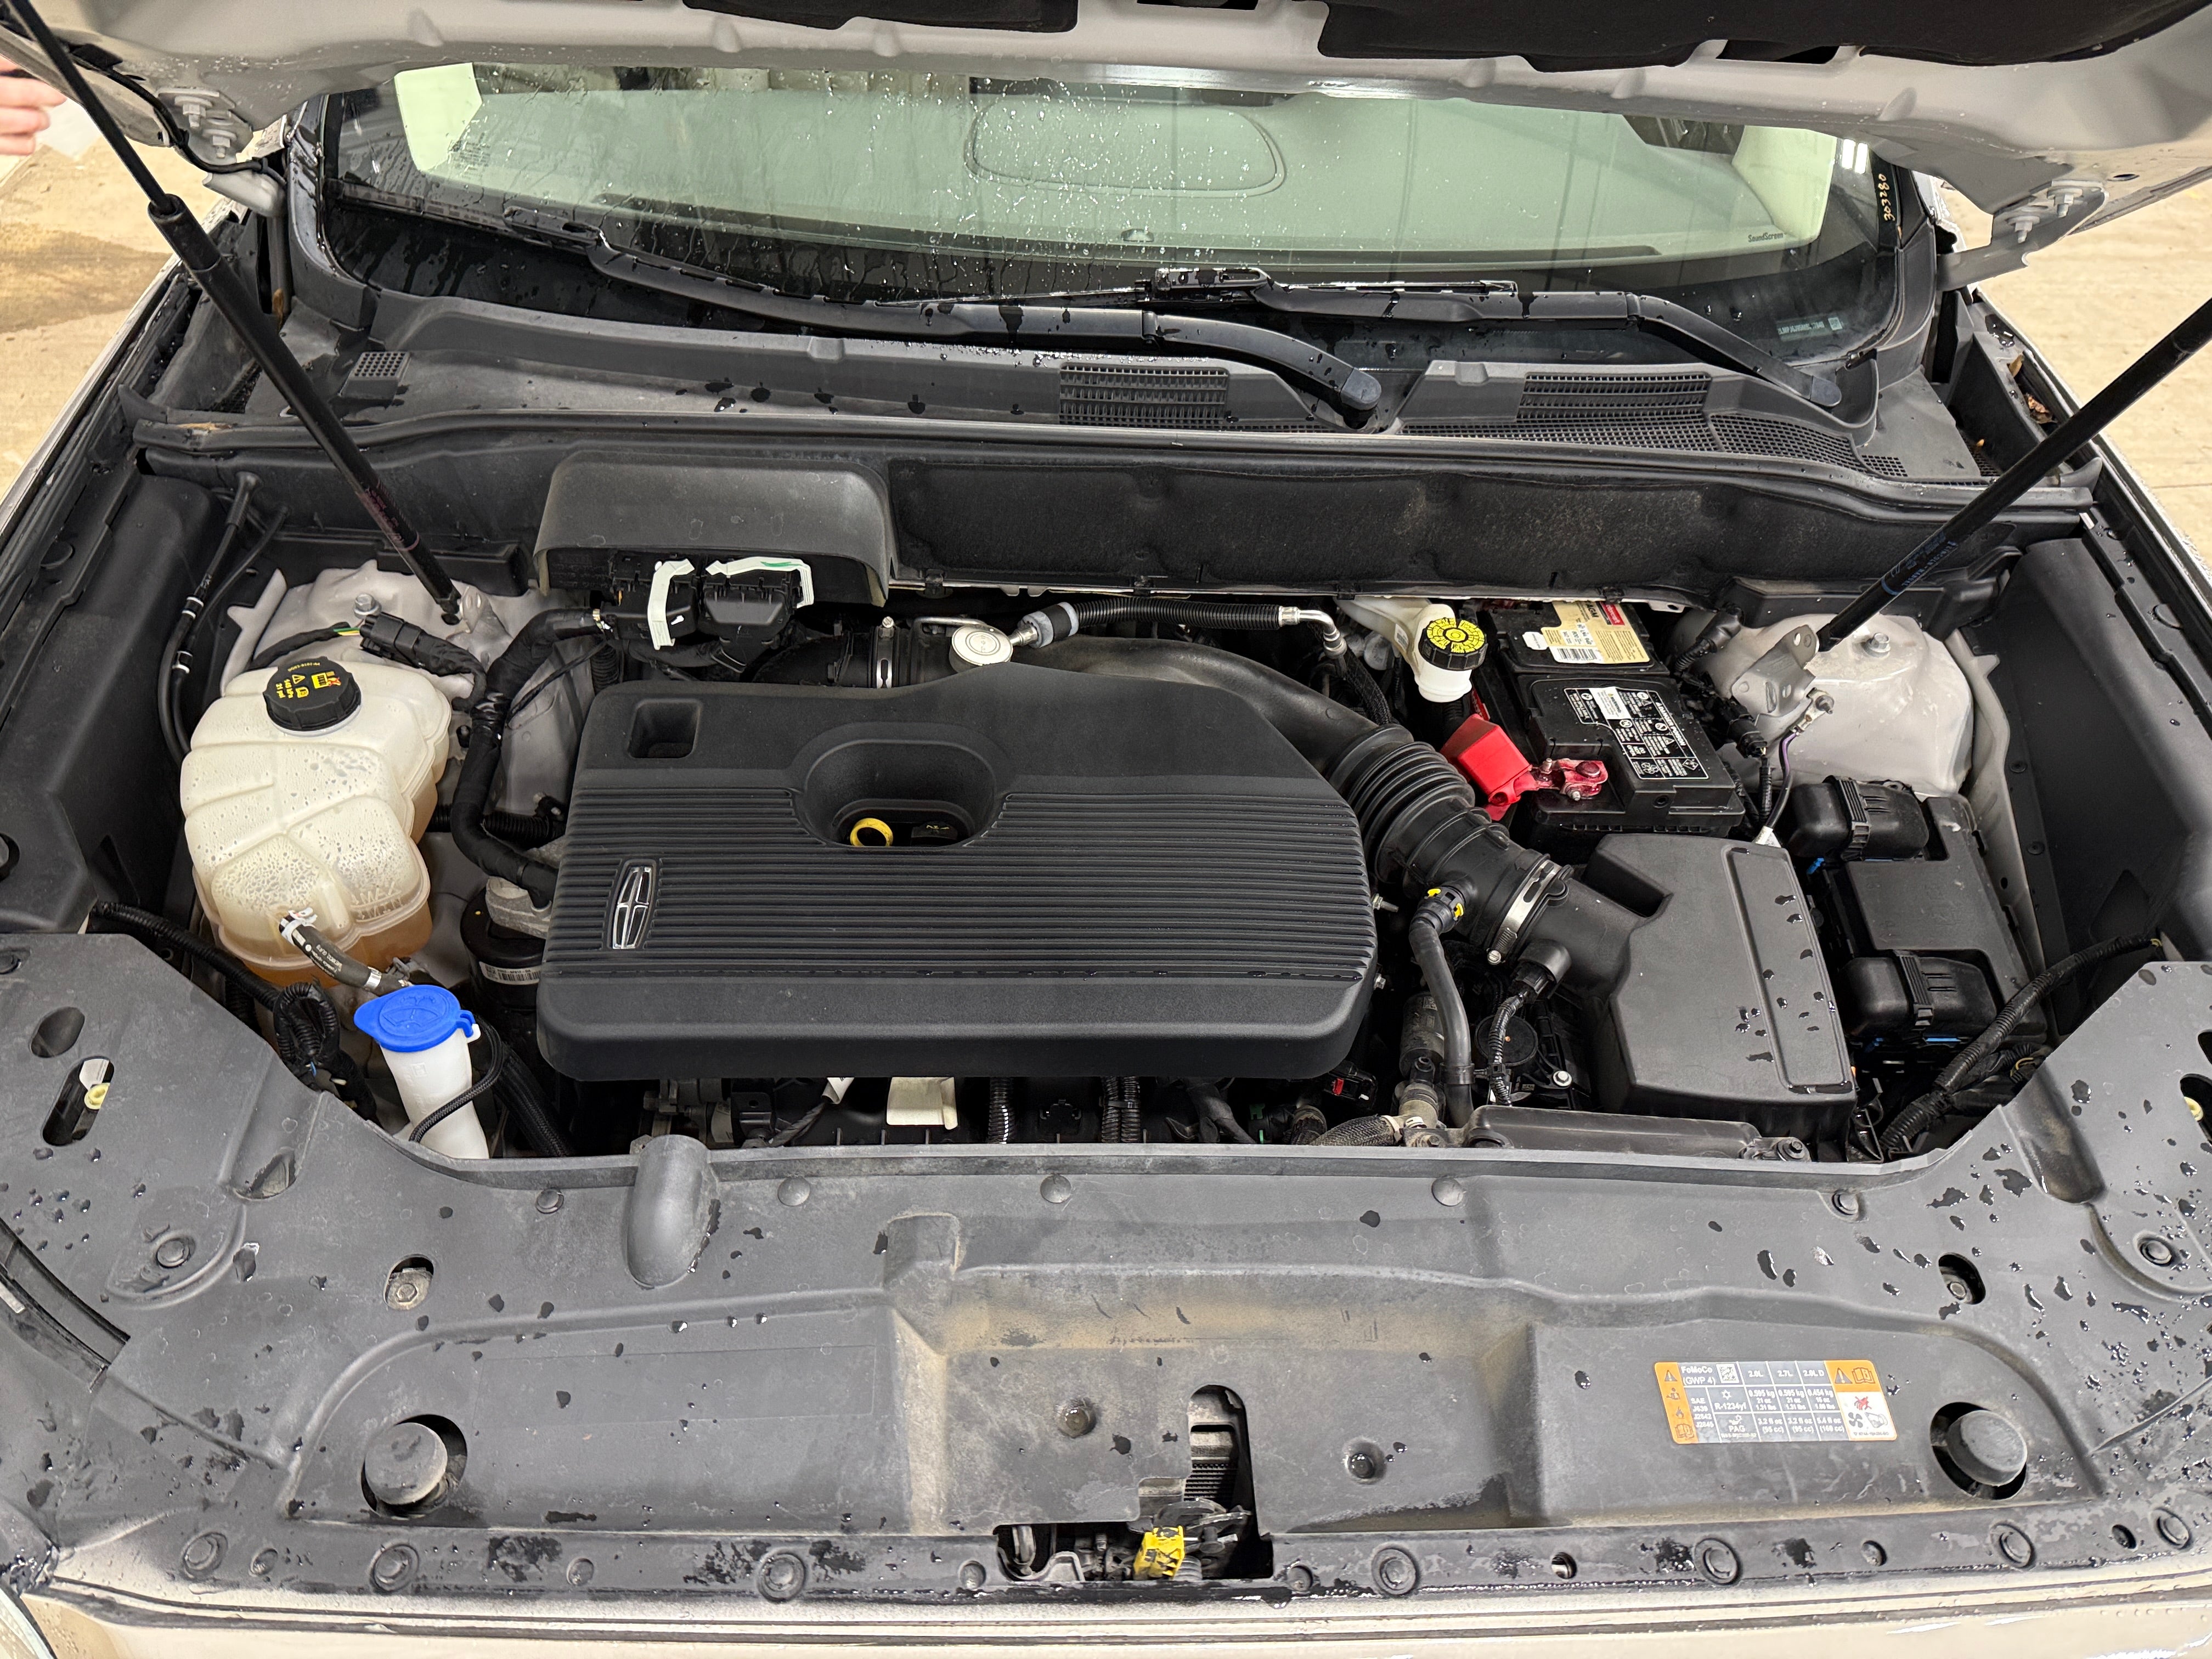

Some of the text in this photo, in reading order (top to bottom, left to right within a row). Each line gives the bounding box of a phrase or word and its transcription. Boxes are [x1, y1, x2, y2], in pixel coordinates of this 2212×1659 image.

[1878, 173, 1895, 221] 303280
[1748, 232, 1784, 242] SoundScreen
[1766, 1389, 1775, 1398] kg
[1796, 1389, 1805, 1398] kg
[1825, 1389, 1833, 1398] kg
[1714, 1402, 1747, 1411] R-1234yf
